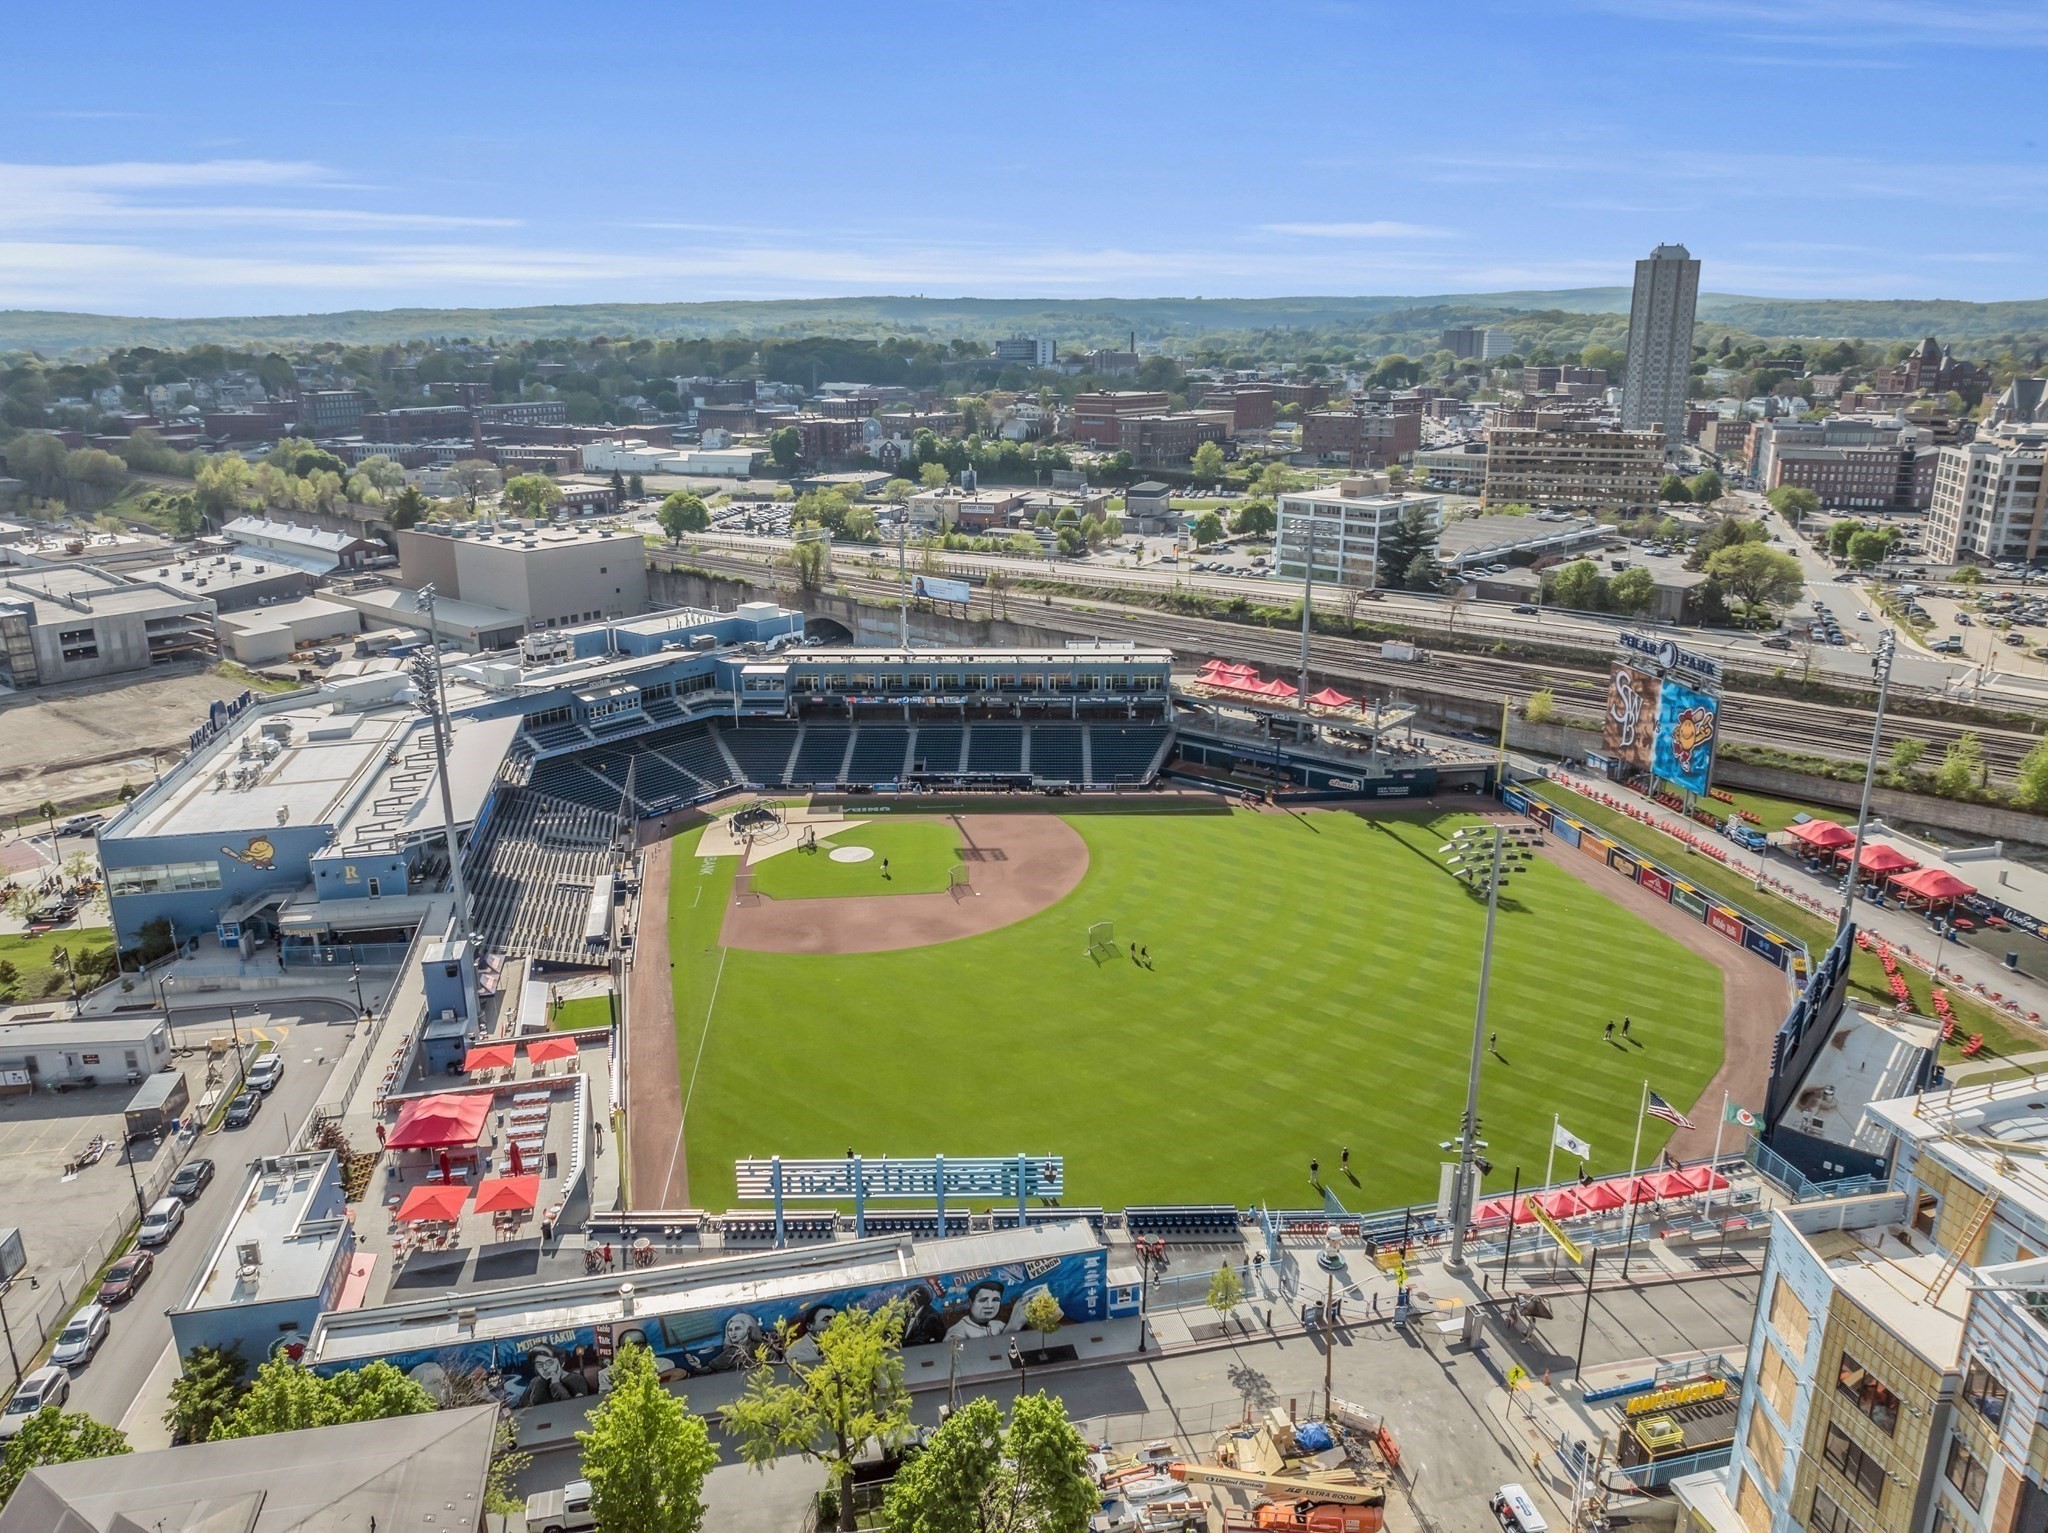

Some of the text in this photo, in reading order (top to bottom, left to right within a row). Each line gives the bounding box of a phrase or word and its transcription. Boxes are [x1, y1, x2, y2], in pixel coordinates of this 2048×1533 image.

[1620, 632, 1716, 675] POLAR PARK
[345, 866, 359, 879] R
[953, 1267, 992, 1287] DINER
[1031, 1259, 1060, 1277] VERNON
[516, 1329, 576, 1353] MOTHER EARTH
[1215, 1478, 1264, 1488] United Rentals
[1305, 1490, 1330, 1498] ULTRA
[1331, 1493, 1356, 1501] BOOM
